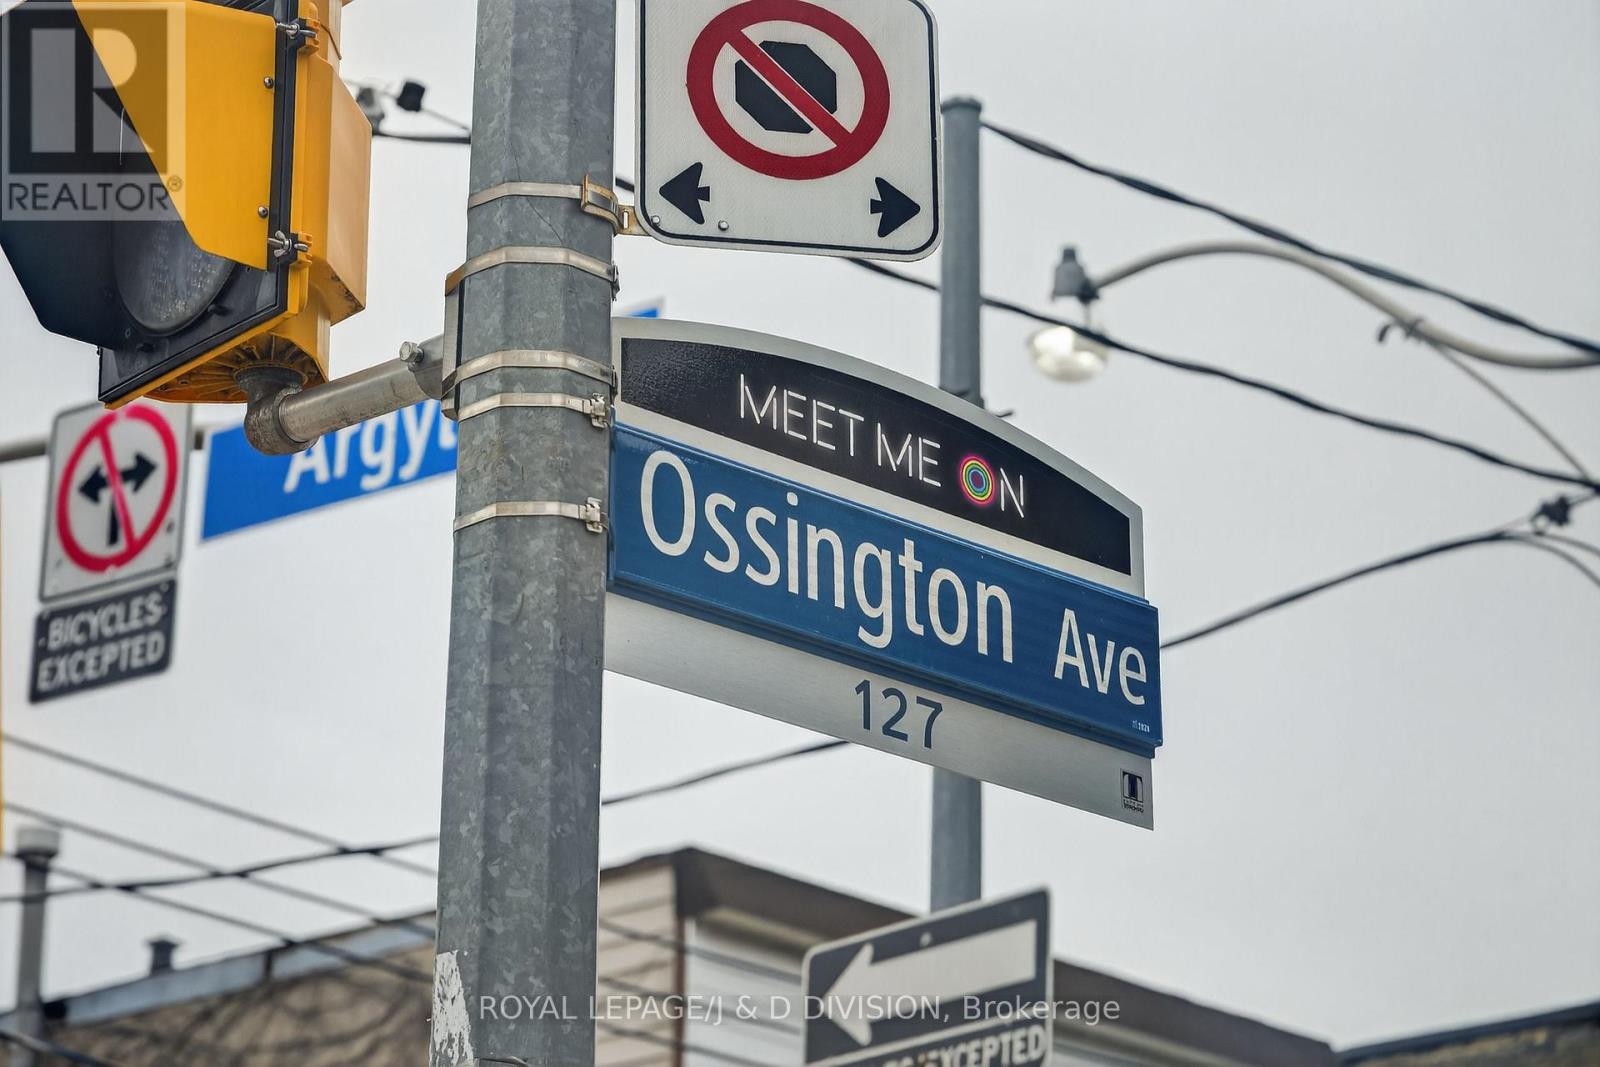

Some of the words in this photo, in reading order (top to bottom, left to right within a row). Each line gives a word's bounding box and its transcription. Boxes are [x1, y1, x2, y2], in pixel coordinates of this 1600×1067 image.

[740, 373, 865, 458] MEET
[876, 422, 942, 488] ME
[957, 454, 1025, 518] ON
[640, 449, 1015, 665] Ossington
[1054, 607, 1148, 706] Ave
[47, 591, 163, 651] BICYCLES
[37, 630, 165, 692] EXCEPTED
[854, 679, 944, 749] 127
